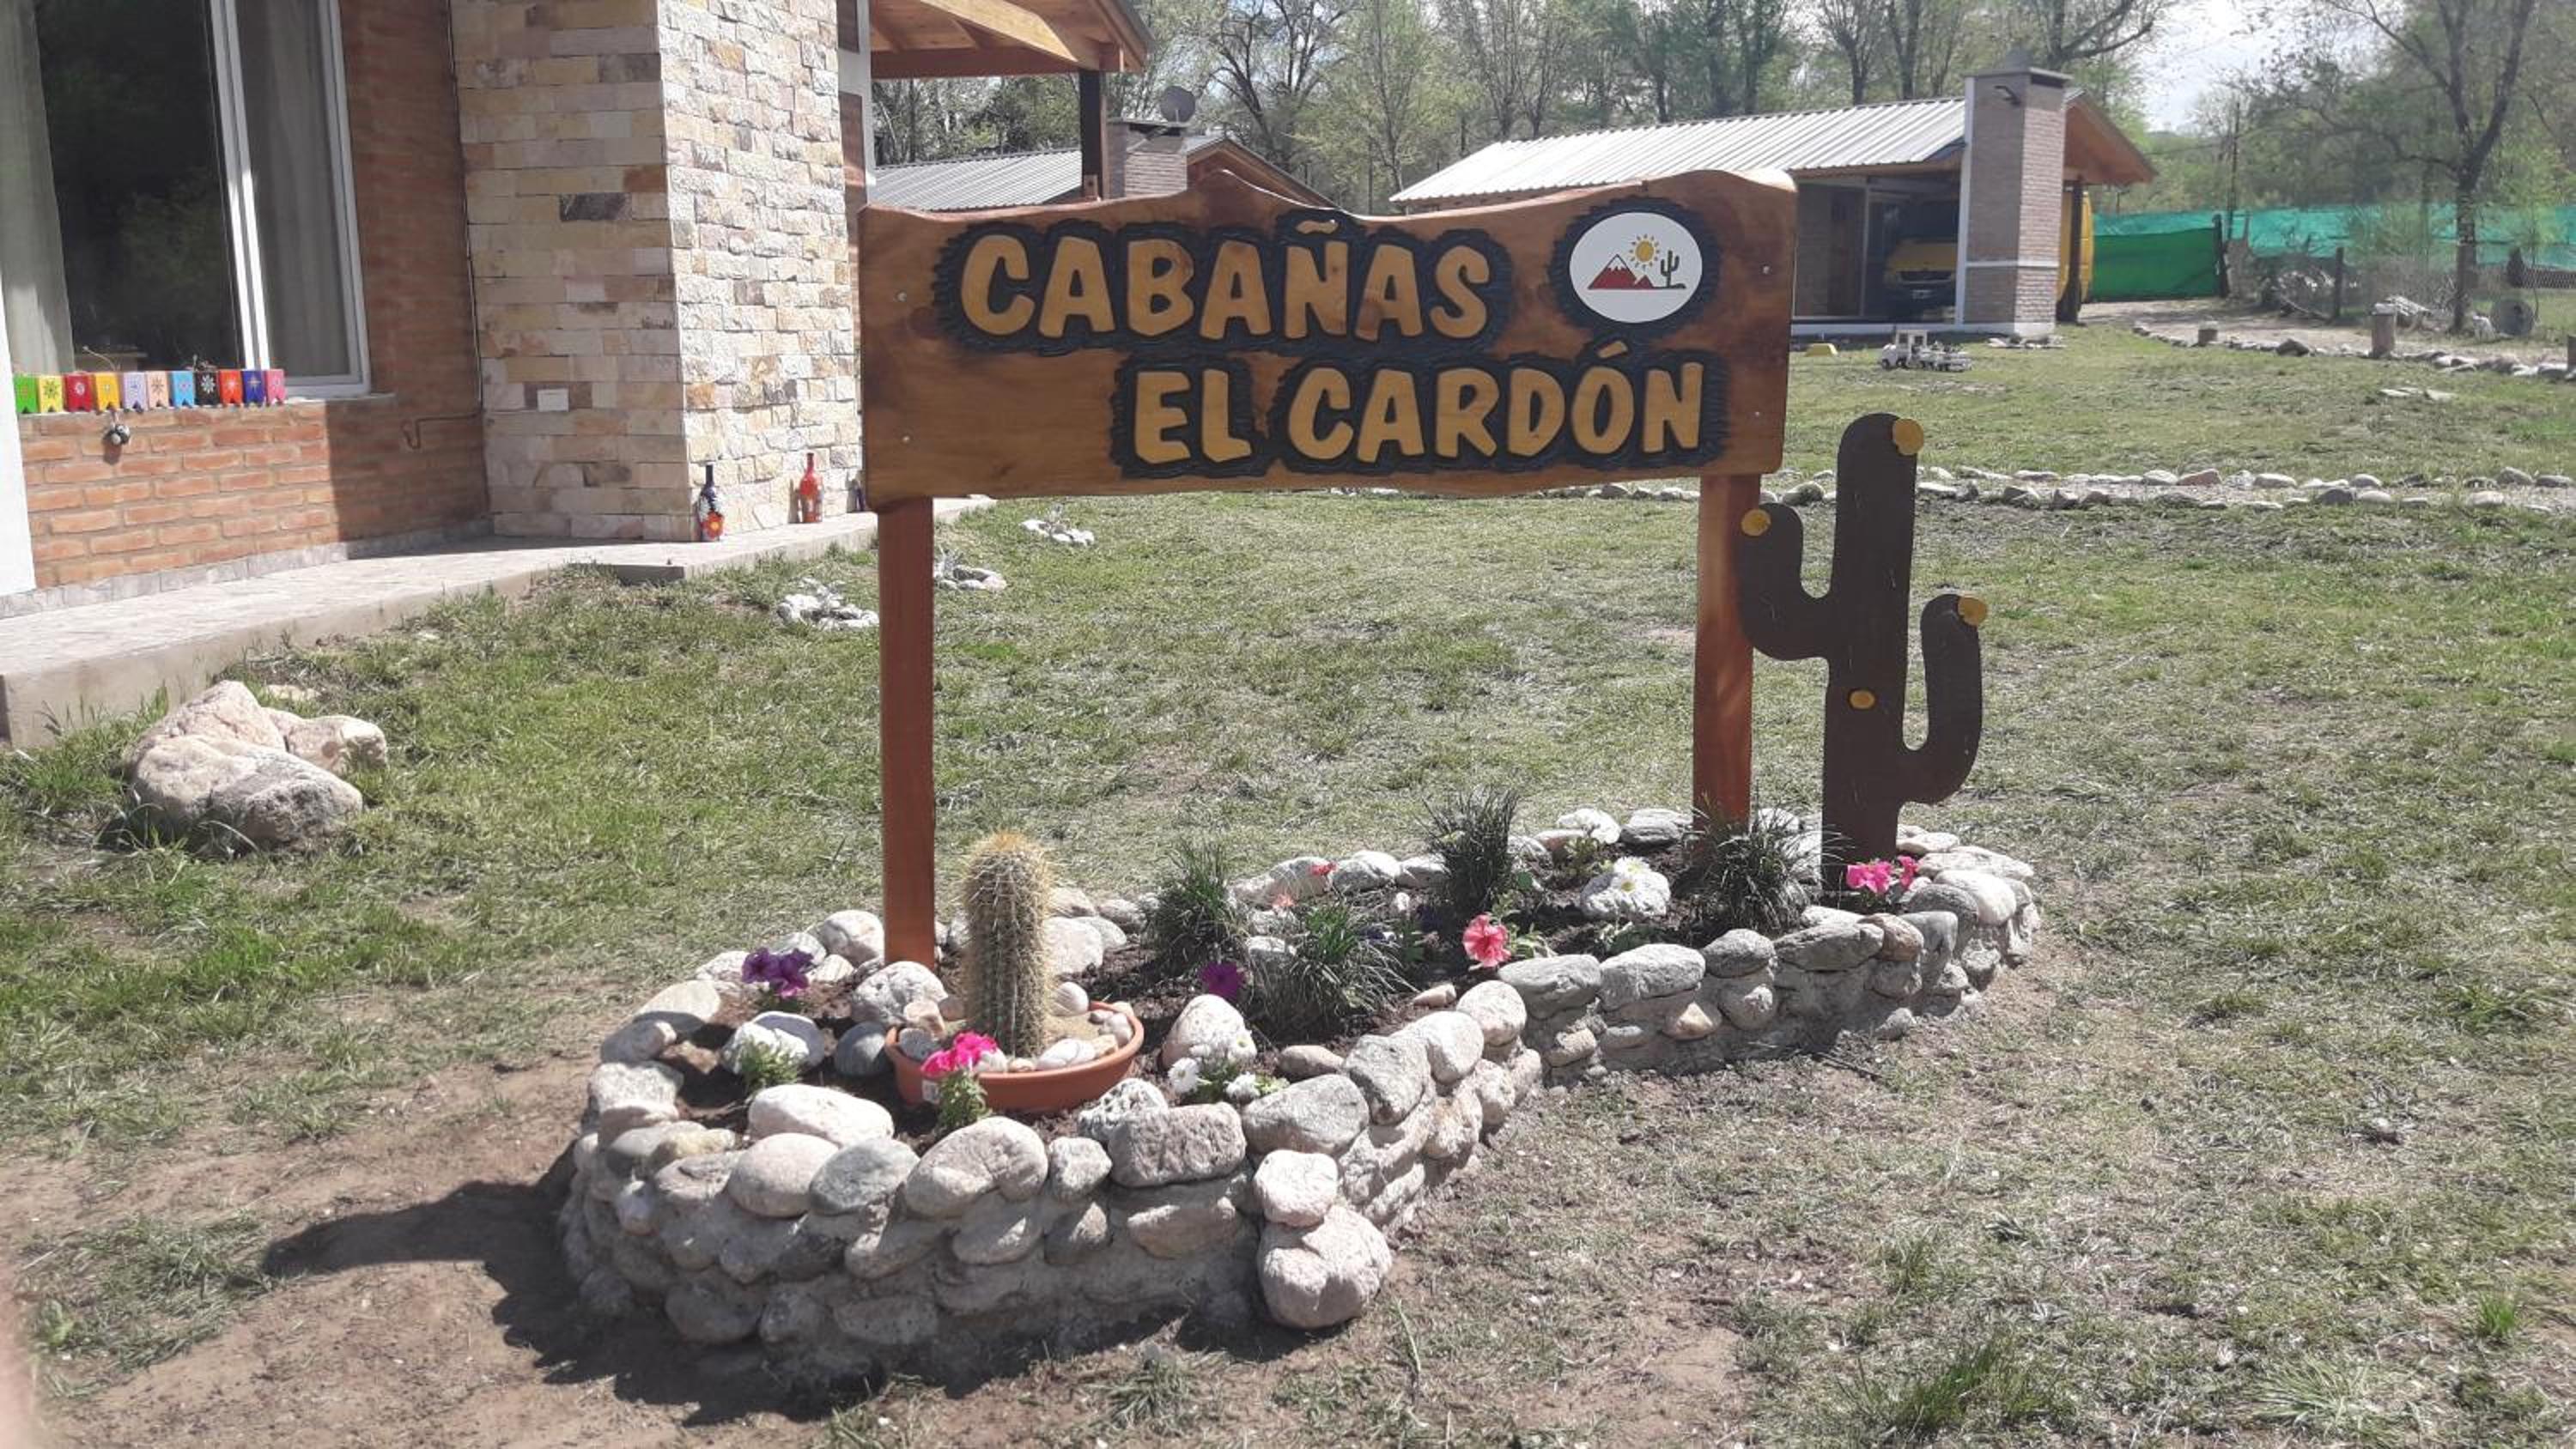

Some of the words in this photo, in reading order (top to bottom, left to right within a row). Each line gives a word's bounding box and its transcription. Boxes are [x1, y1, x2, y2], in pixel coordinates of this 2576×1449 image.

[960, 219, 1491, 340] CABAÑAS
[1134, 368, 1253, 464] EL
[1288, 342, 1704, 462] CARDÓN
